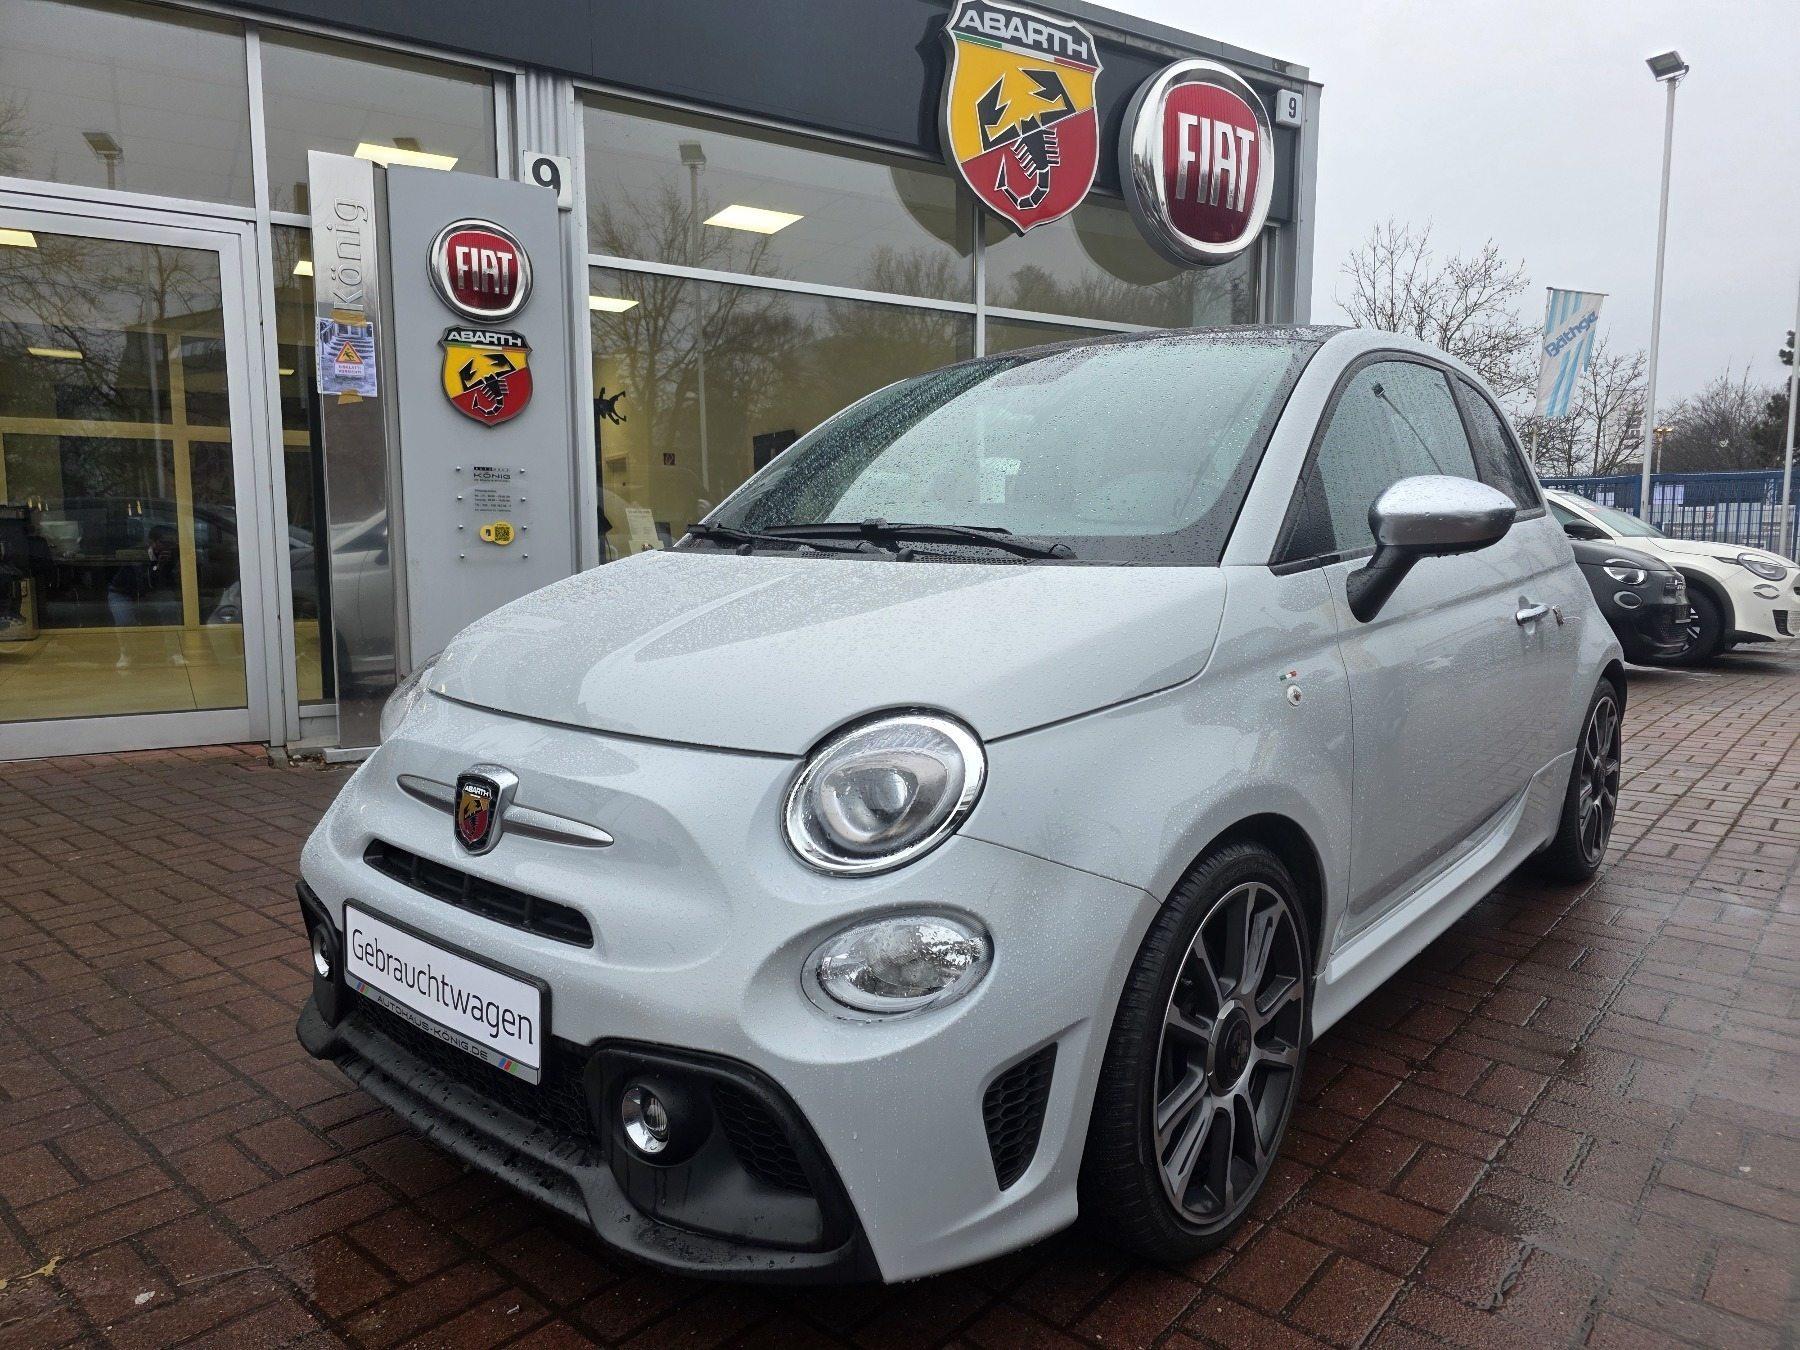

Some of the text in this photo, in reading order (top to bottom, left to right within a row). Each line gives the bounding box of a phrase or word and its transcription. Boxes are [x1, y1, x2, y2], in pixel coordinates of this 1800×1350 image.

[959, 9, 1088, 59] ABARTH
[1288, 97, 1297, 119] 9
[532, 157, 561, 198] 9
[1176, 112, 1254, 212] FIAT
[327, 198, 369, 311] könig
[455, 246, 513, 295] FIAT
[448, 331, 522, 347] ABARTH
[464, 785, 489, 797] ABARTH
[352, 928, 534, 1046] Gebrauchtwagen
[377, 995, 488, 1060] AUTOHAUS-KÖNIG.DE
